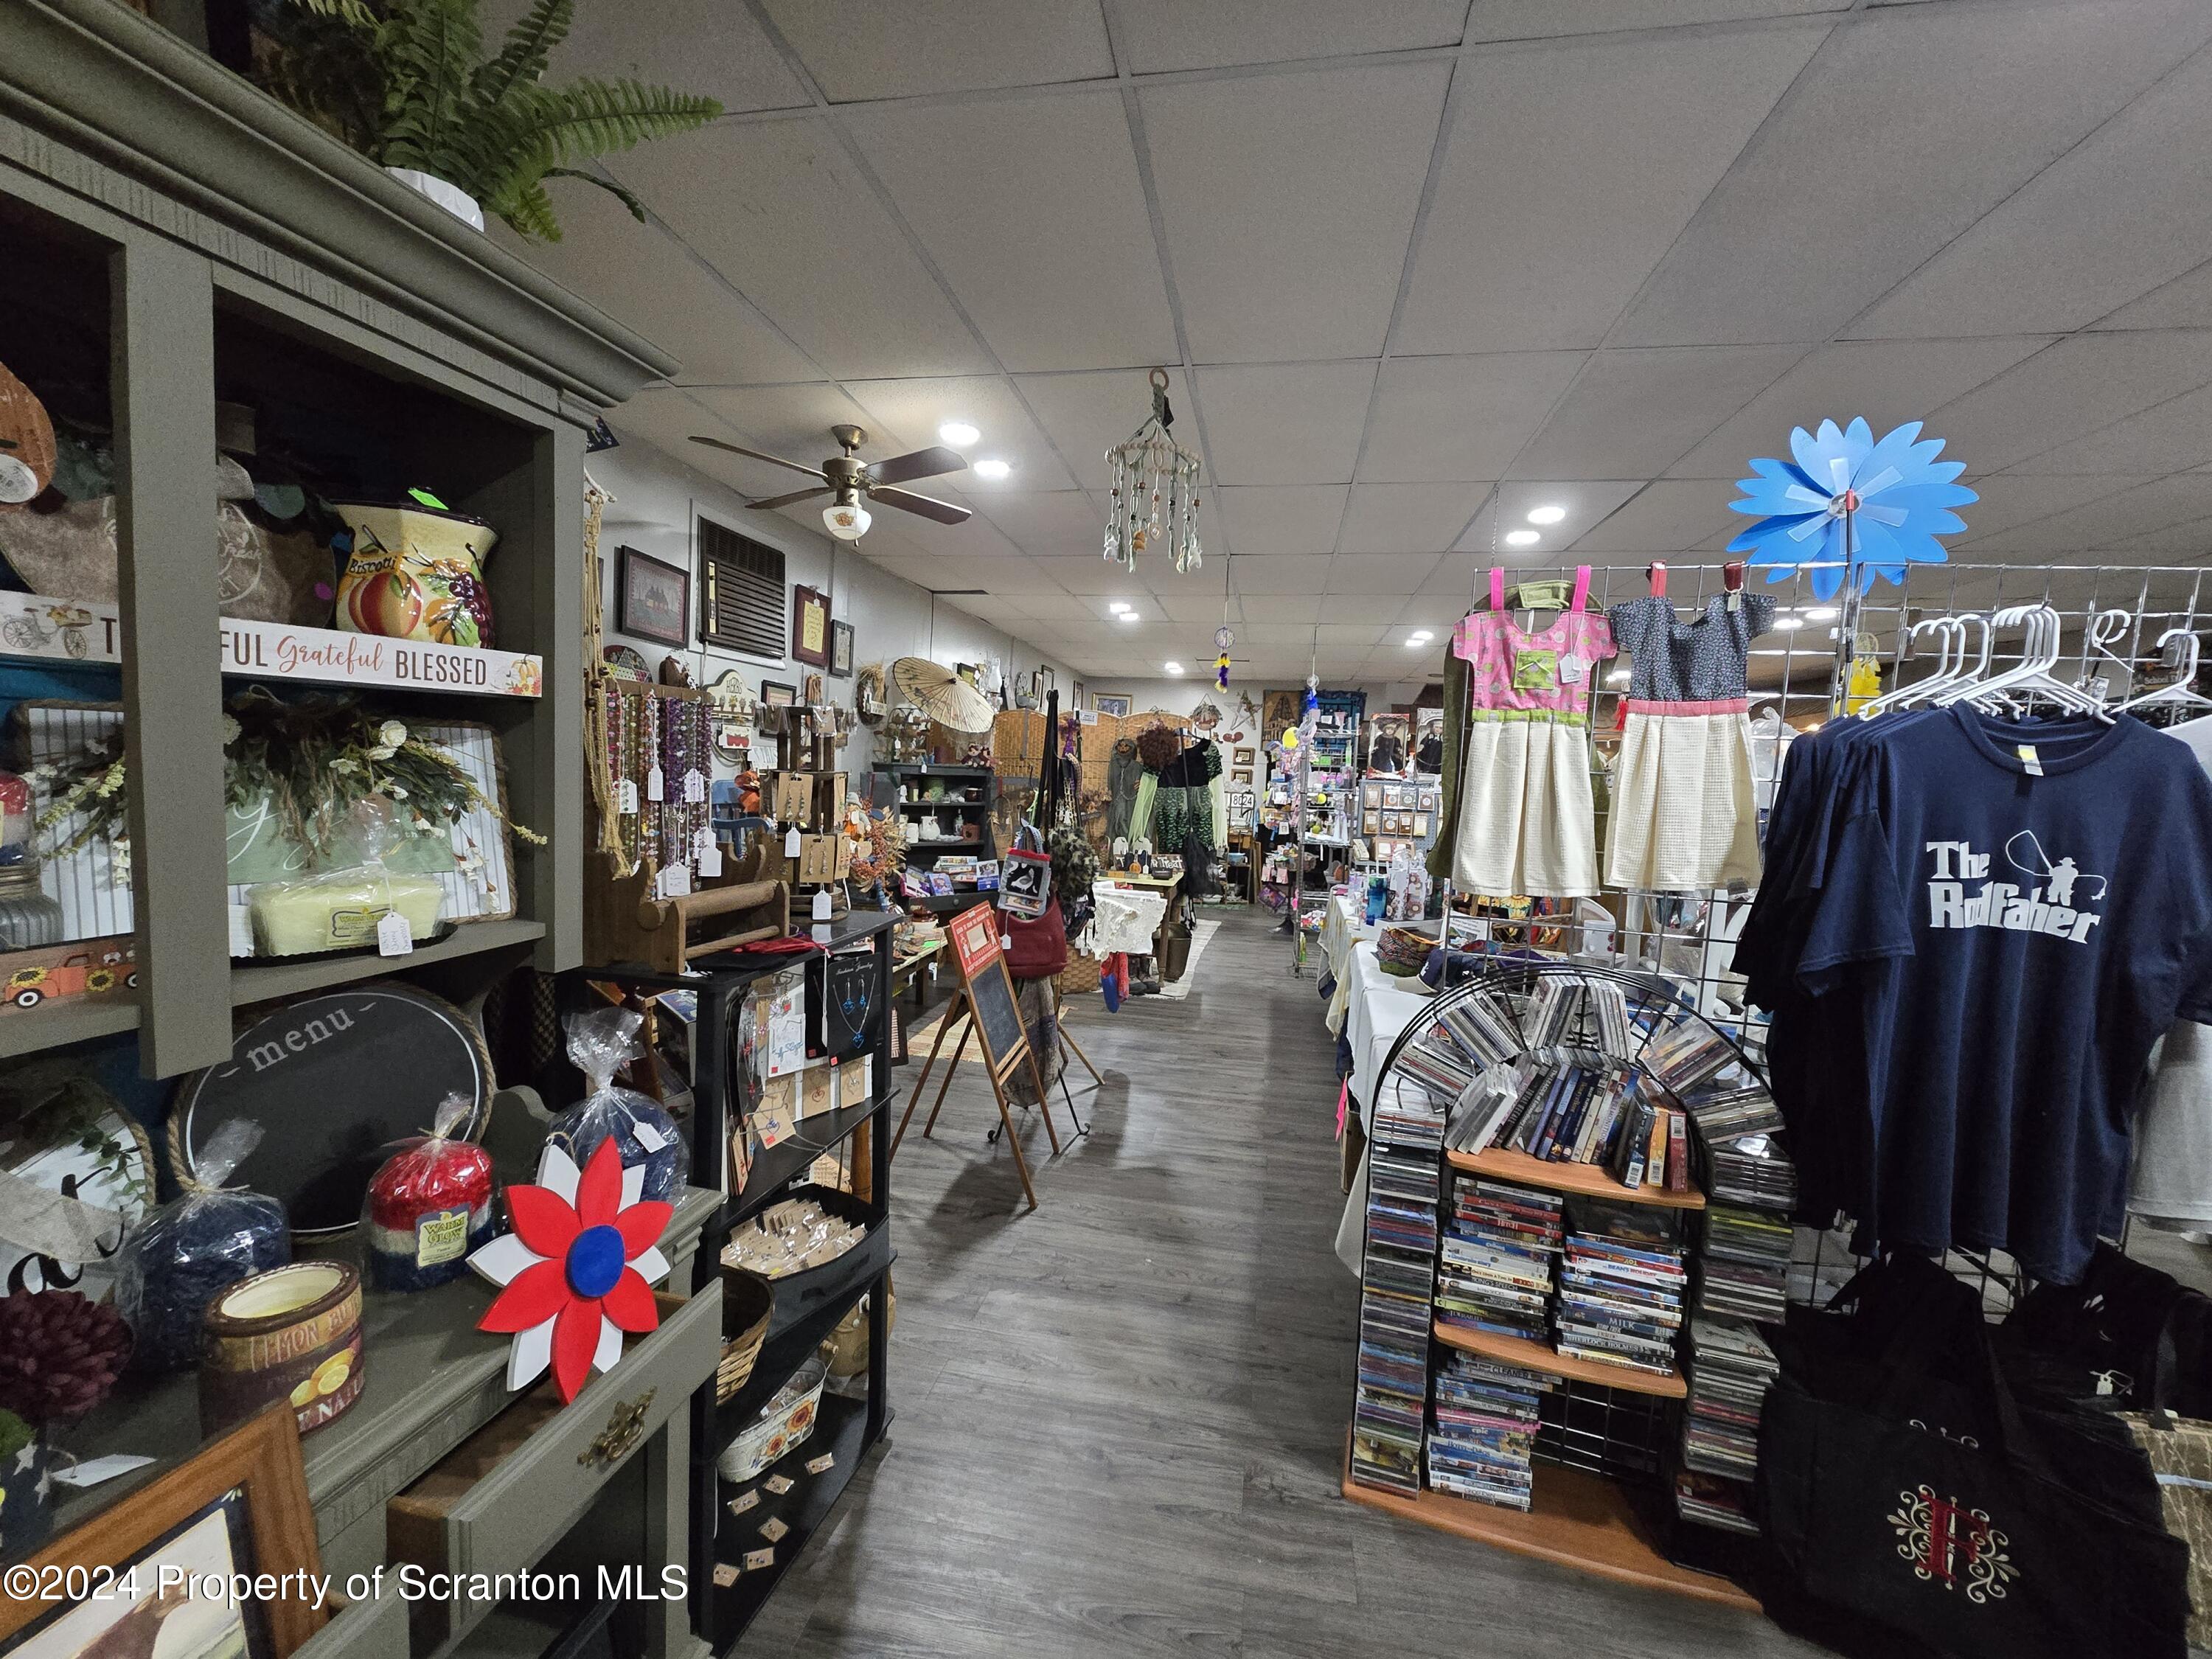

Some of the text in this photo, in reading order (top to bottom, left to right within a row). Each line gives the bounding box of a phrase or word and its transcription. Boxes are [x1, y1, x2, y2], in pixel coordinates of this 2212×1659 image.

[349, 555, 397, 574] Biscotti
[276, 635, 383, 672] Grateful
[395, 650, 487, 686] BLESSED
[1158, 855, 1183, 869] Treat
[1926, 841, 1991, 879] The
[246, 1008, 355, 1072] menu
[424, 1217, 465, 1234] WARM
[1498, 1220, 1518, 1230] HITCH
[428, 1226, 463, 1245] GLOW
[1609, 1317, 1635, 1330] MILK
[251, 1322, 319, 1373] LEMON
[1568, 1335, 1638, 1352] SHERLOCK HOLMES
[1492, 1366, 1528, 1379] CLEANER
[1471, 1427, 1488, 1435] epic
